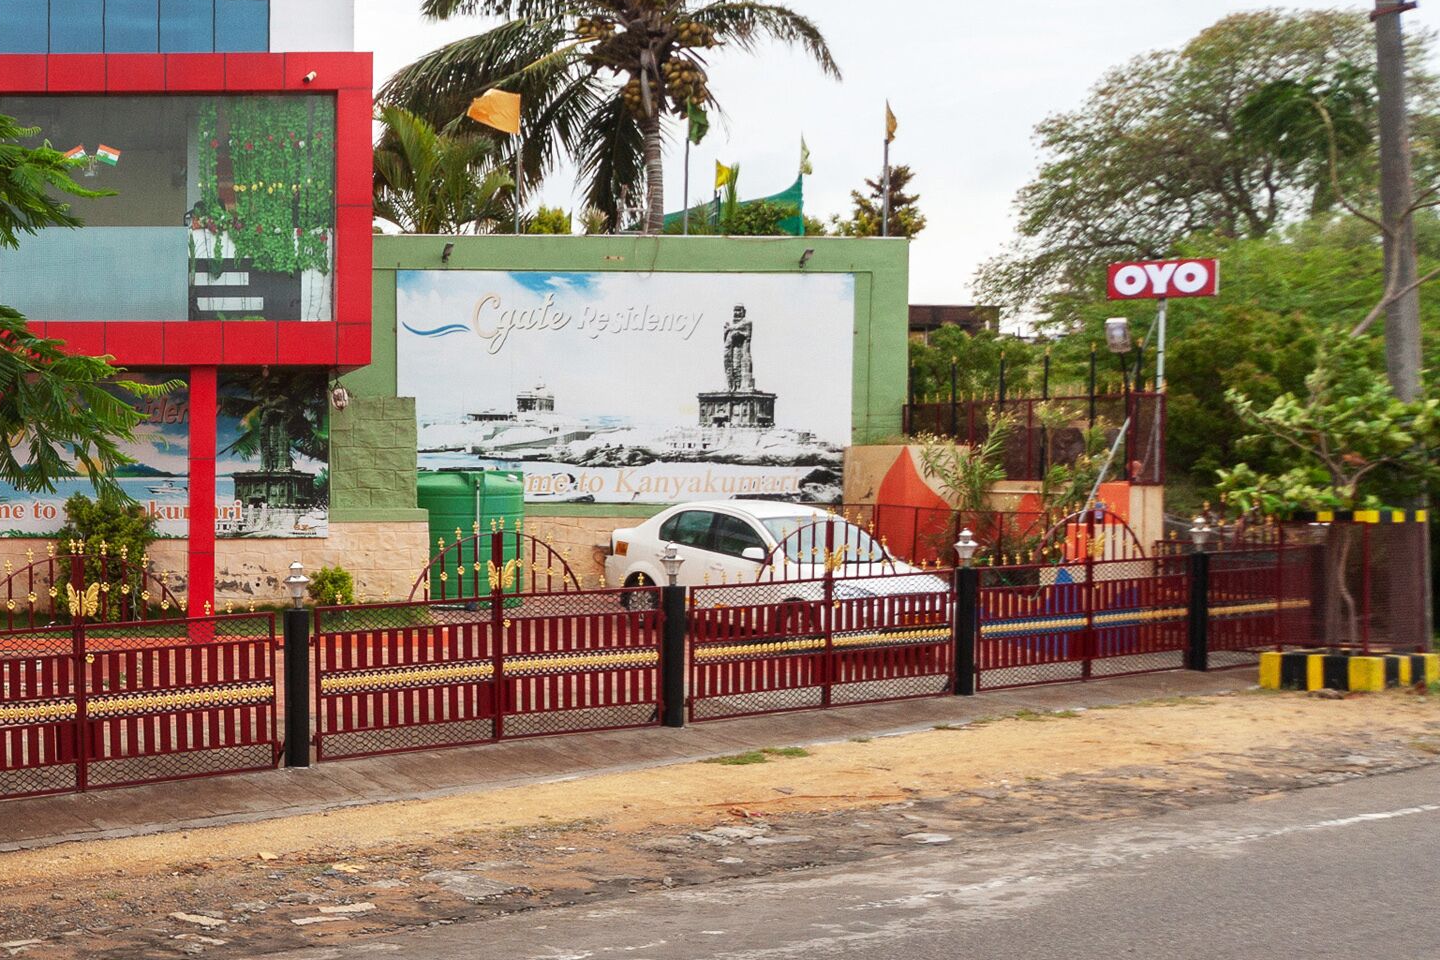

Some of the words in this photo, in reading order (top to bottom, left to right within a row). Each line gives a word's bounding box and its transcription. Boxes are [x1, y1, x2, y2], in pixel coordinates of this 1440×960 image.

[1114, 262, 1208, 296] OYO
[472, 292, 572, 355] Cgate
[576, 304, 704, 340] Residency
[579, 469, 605, 494] to
[615, 467, 800, 500] Kanyakumari
[33, 500, 58, 520] to
